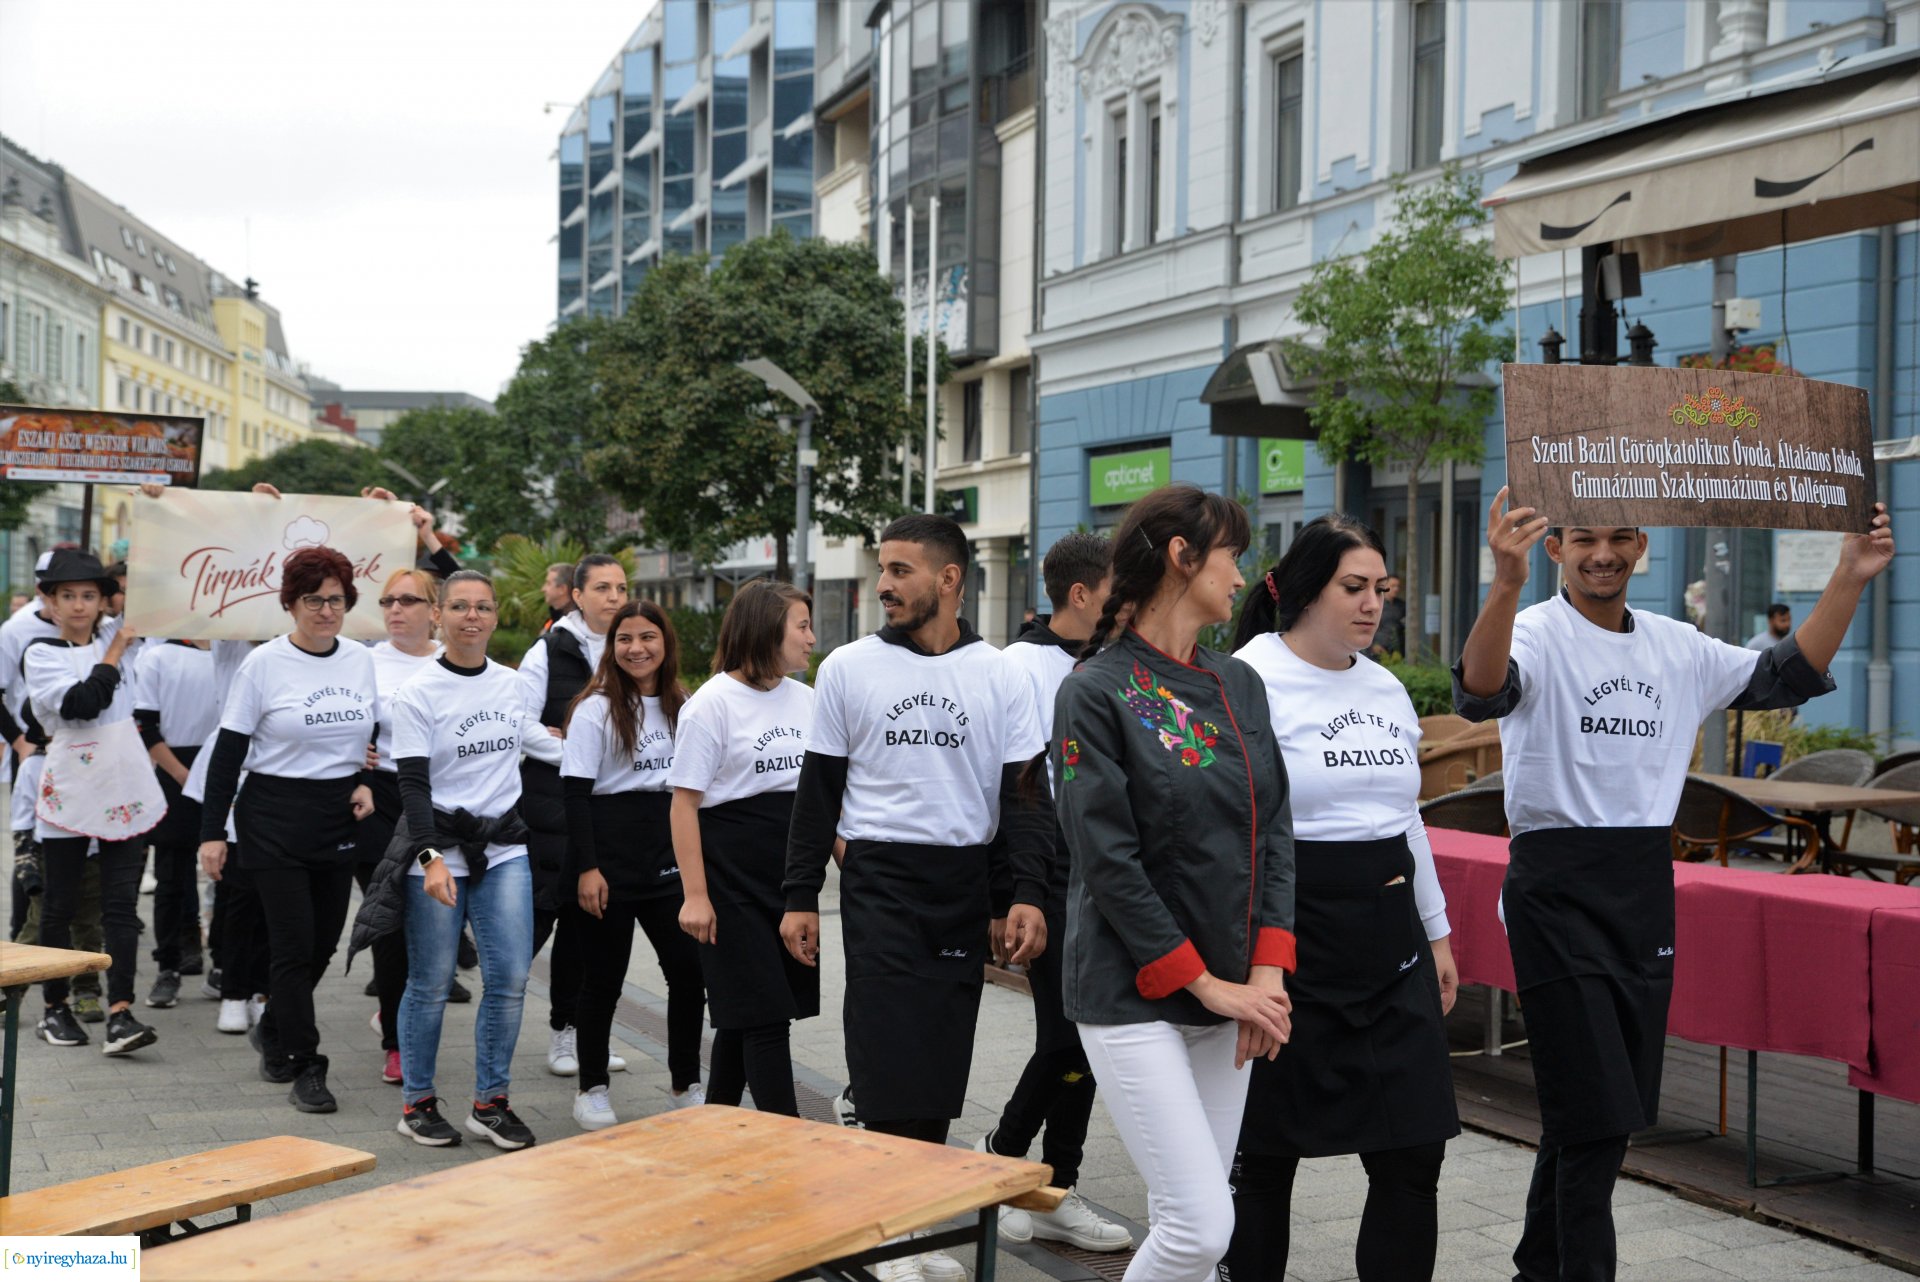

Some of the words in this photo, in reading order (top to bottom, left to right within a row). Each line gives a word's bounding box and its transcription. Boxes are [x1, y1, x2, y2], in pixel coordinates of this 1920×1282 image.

[131, 435, 168, 454] VILMOS
[1532, 436, 1574, 465] Szent
[1578, 436, 1616, 465] Bazil
[1620, 436, 1730, 470] Görögkatolikus
[1732, 435, 1775, 470] Óvoda,
[1778, 439, 1831, 472] Általános
[1833, 448, 1865, 479] Iskola,
[1104, 460, 1154, 492] opticnet
[1266, 475, 1303, 489] OPTIKA
[1572, 470, 1659, 500] Gimnázium
[1662, 472, 1772, 504] Szakgimnázium
[1774, 476, 1788, 502] és
[1790, 477, 1848, 509] Kollégium
[180, 546, 277, 617] Tirpák
[303, 685, 337, 708] LEGYÉL
[339, 687, 352, 697] TE
[353, 692, 362, 703] IS
[1584, 674, 1633, 706] LEGYÉL
[1637, 681, 1654, 699] TE
[886, 691, 936, 721] LEGYÉL
[941, 697, 957, 714] TE
[956, 711, 970, 726] IS
[455, 709, 492, 737] LEGYÉL
[494, 711, 506, 722] TE
[509, 716, 518, 728] IS
[1320, 708, 1366, 741] LEGYÉL
[1367, 713, 1385, 728] TE
[1389, 722, 1400, 738] IS
[1580, 716, 1656, 738] BAZILOS
[457, 736, 515, 758] BAZILOS
[634, 729, 667, 753] LEGYÉL
[754, 726, 788, 752] LEGYÉL
[790, 727, 802, 739] TE
[633, 756, 675, 772] BAZIL
[755, 754, 804, 774] BAZILO
[1323, 748, 1405, 767] BAZILOS
